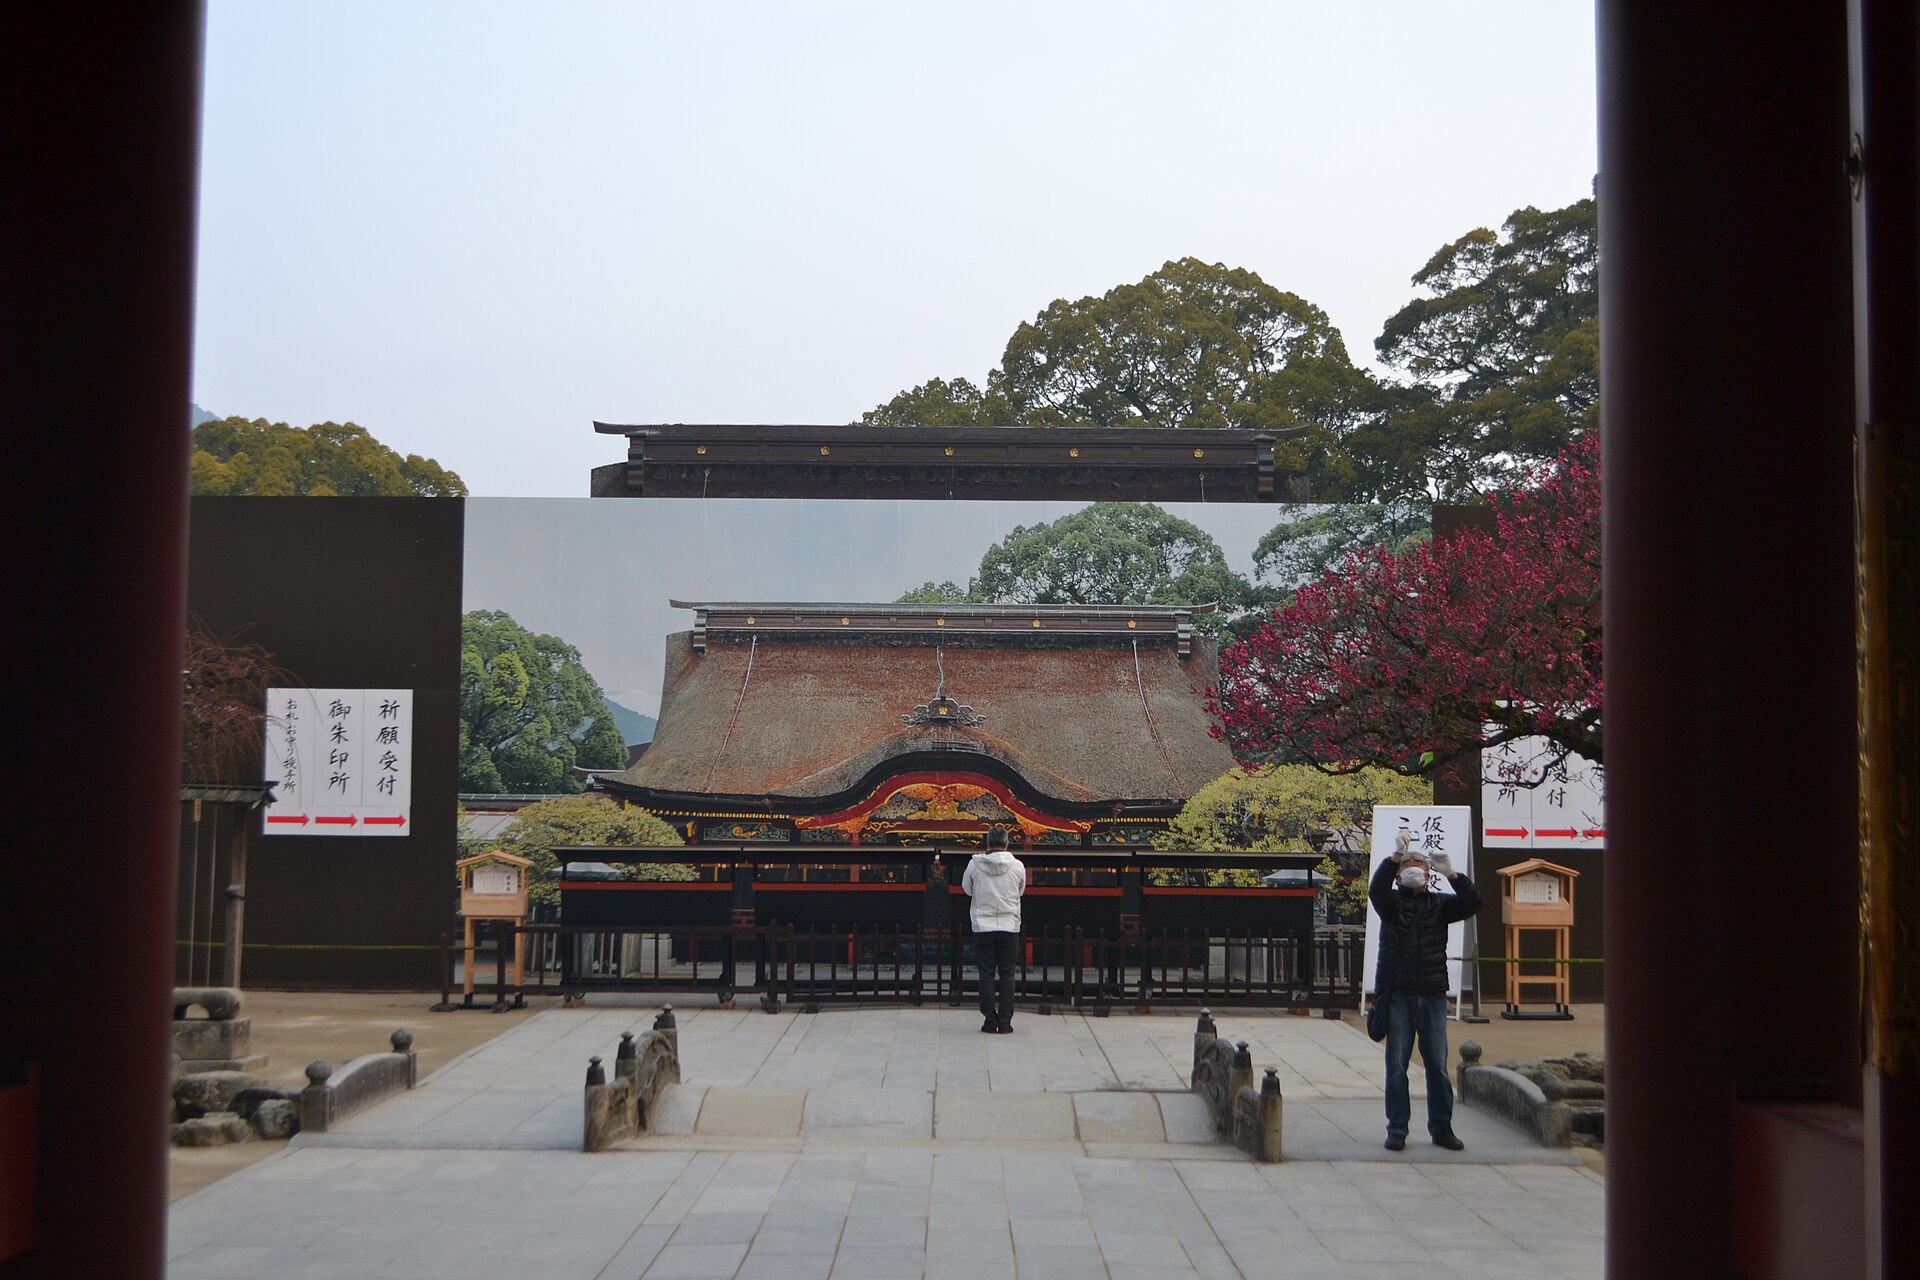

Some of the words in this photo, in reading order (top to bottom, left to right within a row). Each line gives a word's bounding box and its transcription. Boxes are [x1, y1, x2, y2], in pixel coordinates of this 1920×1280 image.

[327, 698, 352, 796] 御朱印所
[375, 698, 401, 797] 祈願受付
